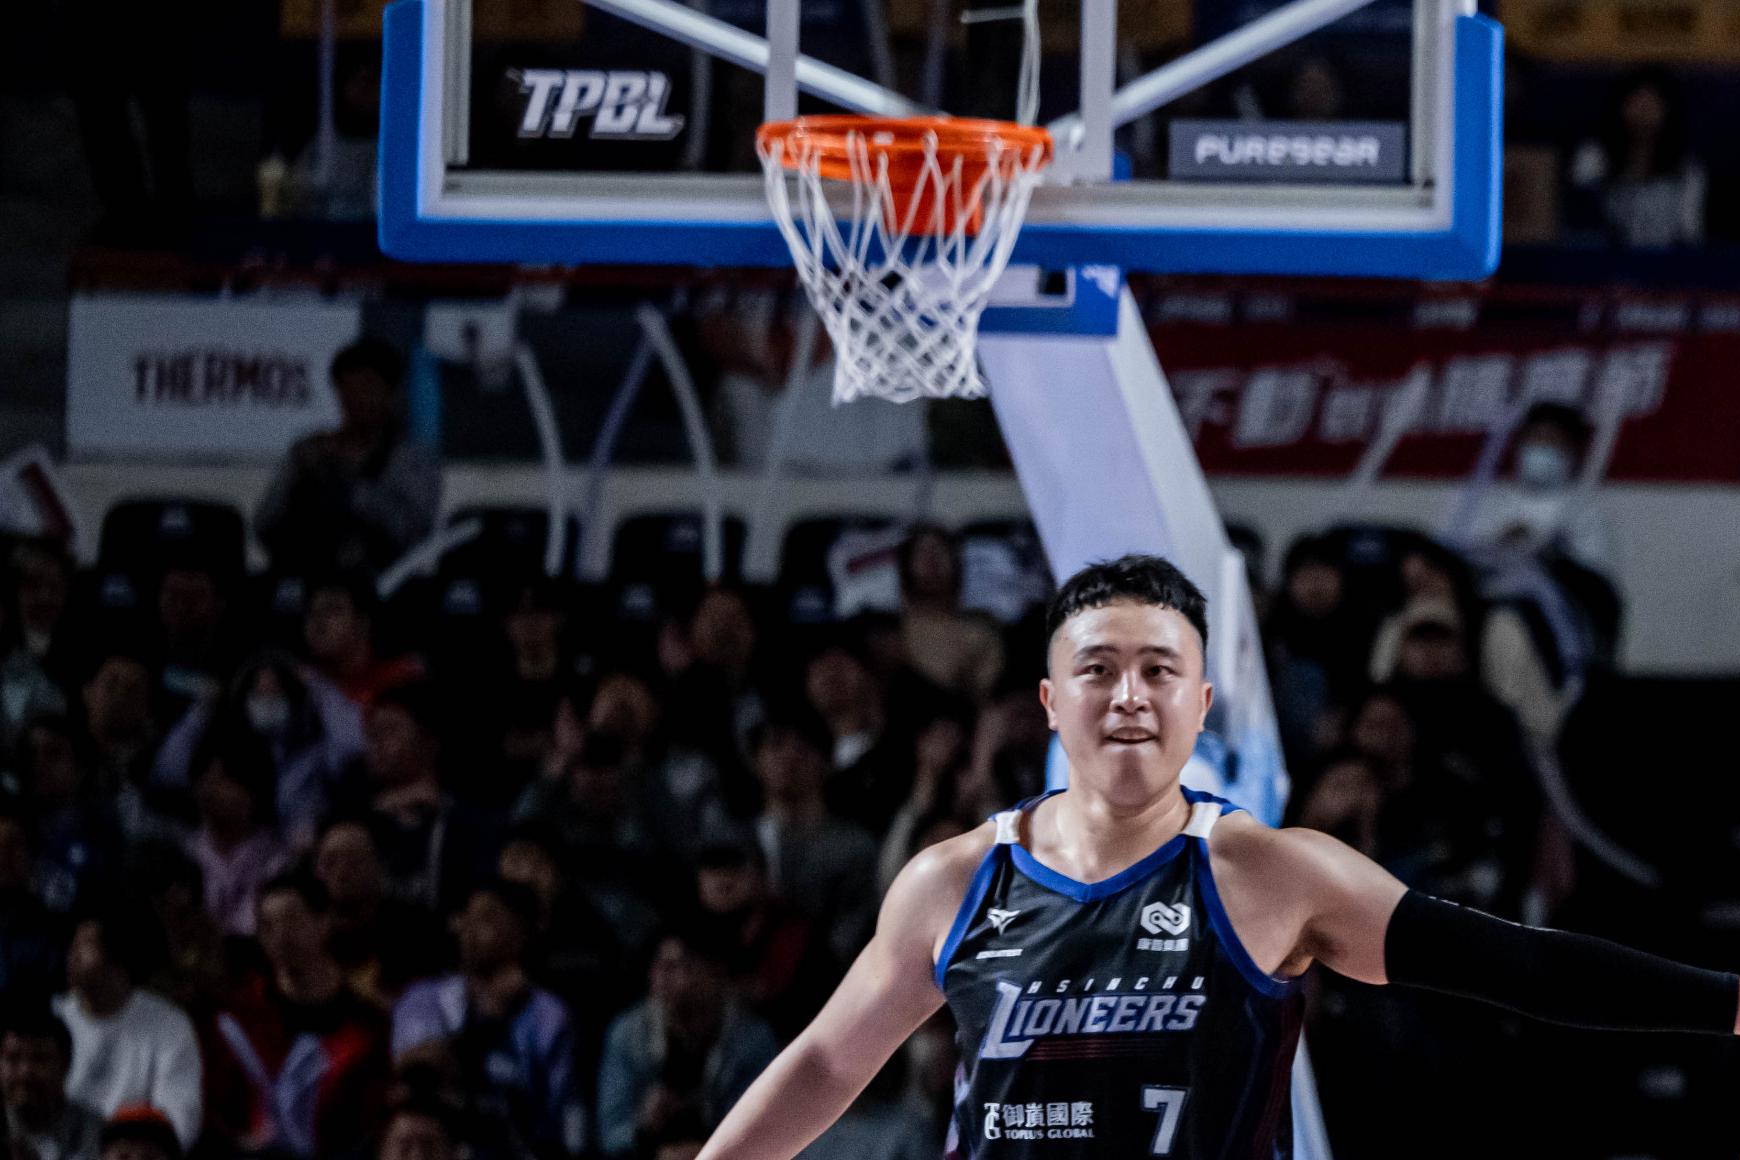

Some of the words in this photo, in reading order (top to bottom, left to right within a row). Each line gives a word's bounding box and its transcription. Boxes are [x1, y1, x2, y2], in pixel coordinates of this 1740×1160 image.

[515, 68, 685, 140] TPBL
[133, 352, 310, 406] THERMOS
[980, 980, 1207, 1060] LIONEERS
[1027, 976, 1205, 994] HSINCHU
[1140, 1085, 1190, 1156] 7
